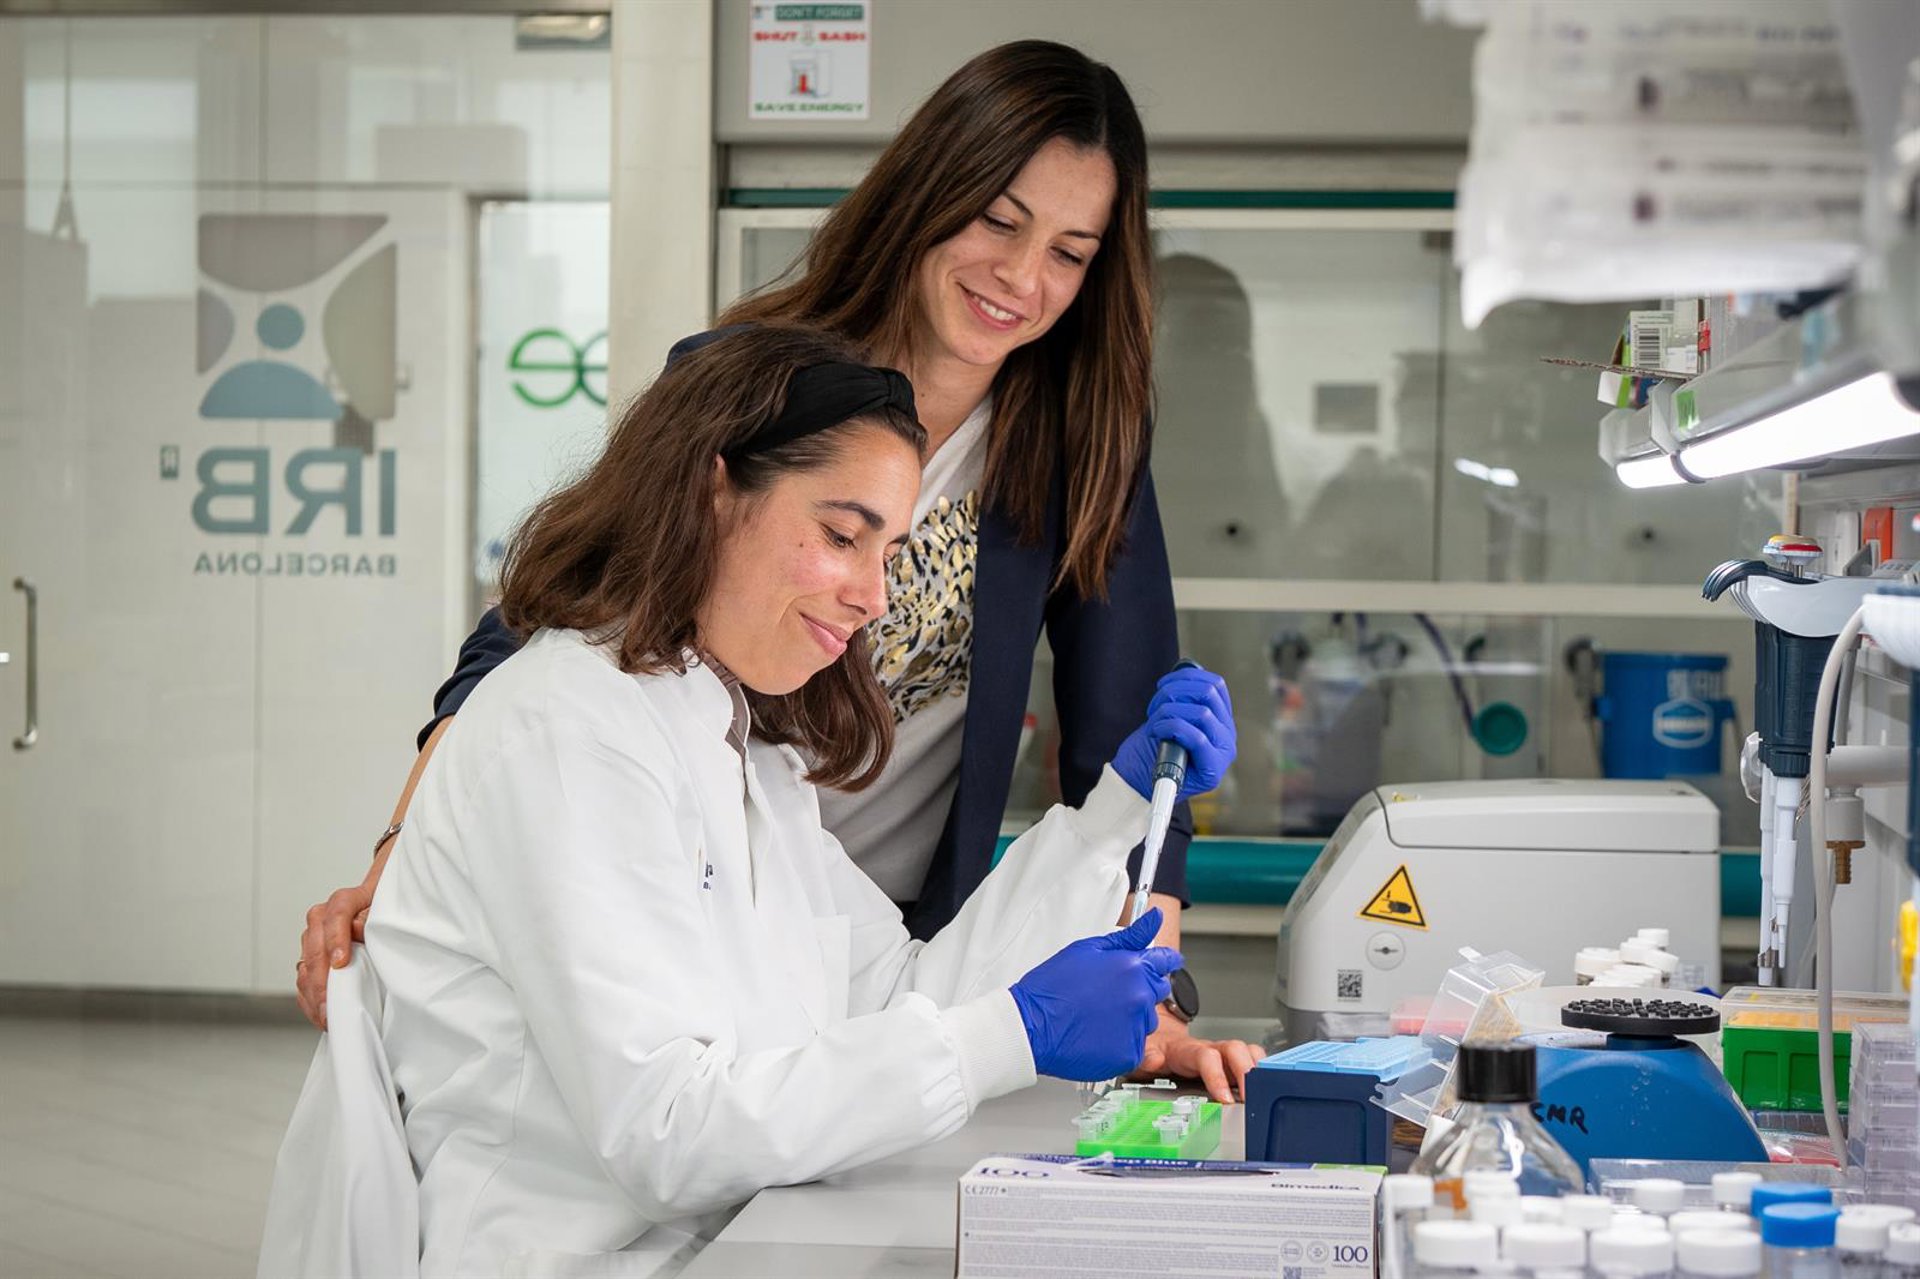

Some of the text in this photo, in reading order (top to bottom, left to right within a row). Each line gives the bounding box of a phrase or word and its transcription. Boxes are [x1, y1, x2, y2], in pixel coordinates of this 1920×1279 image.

[815, 7, 862, 19] FORGET
[754, 31, 866, 42] SHUT SASH
[754, 103, 863, 112] SAVE ENERGY
[1333, 1245, 1368, 1263] 100
